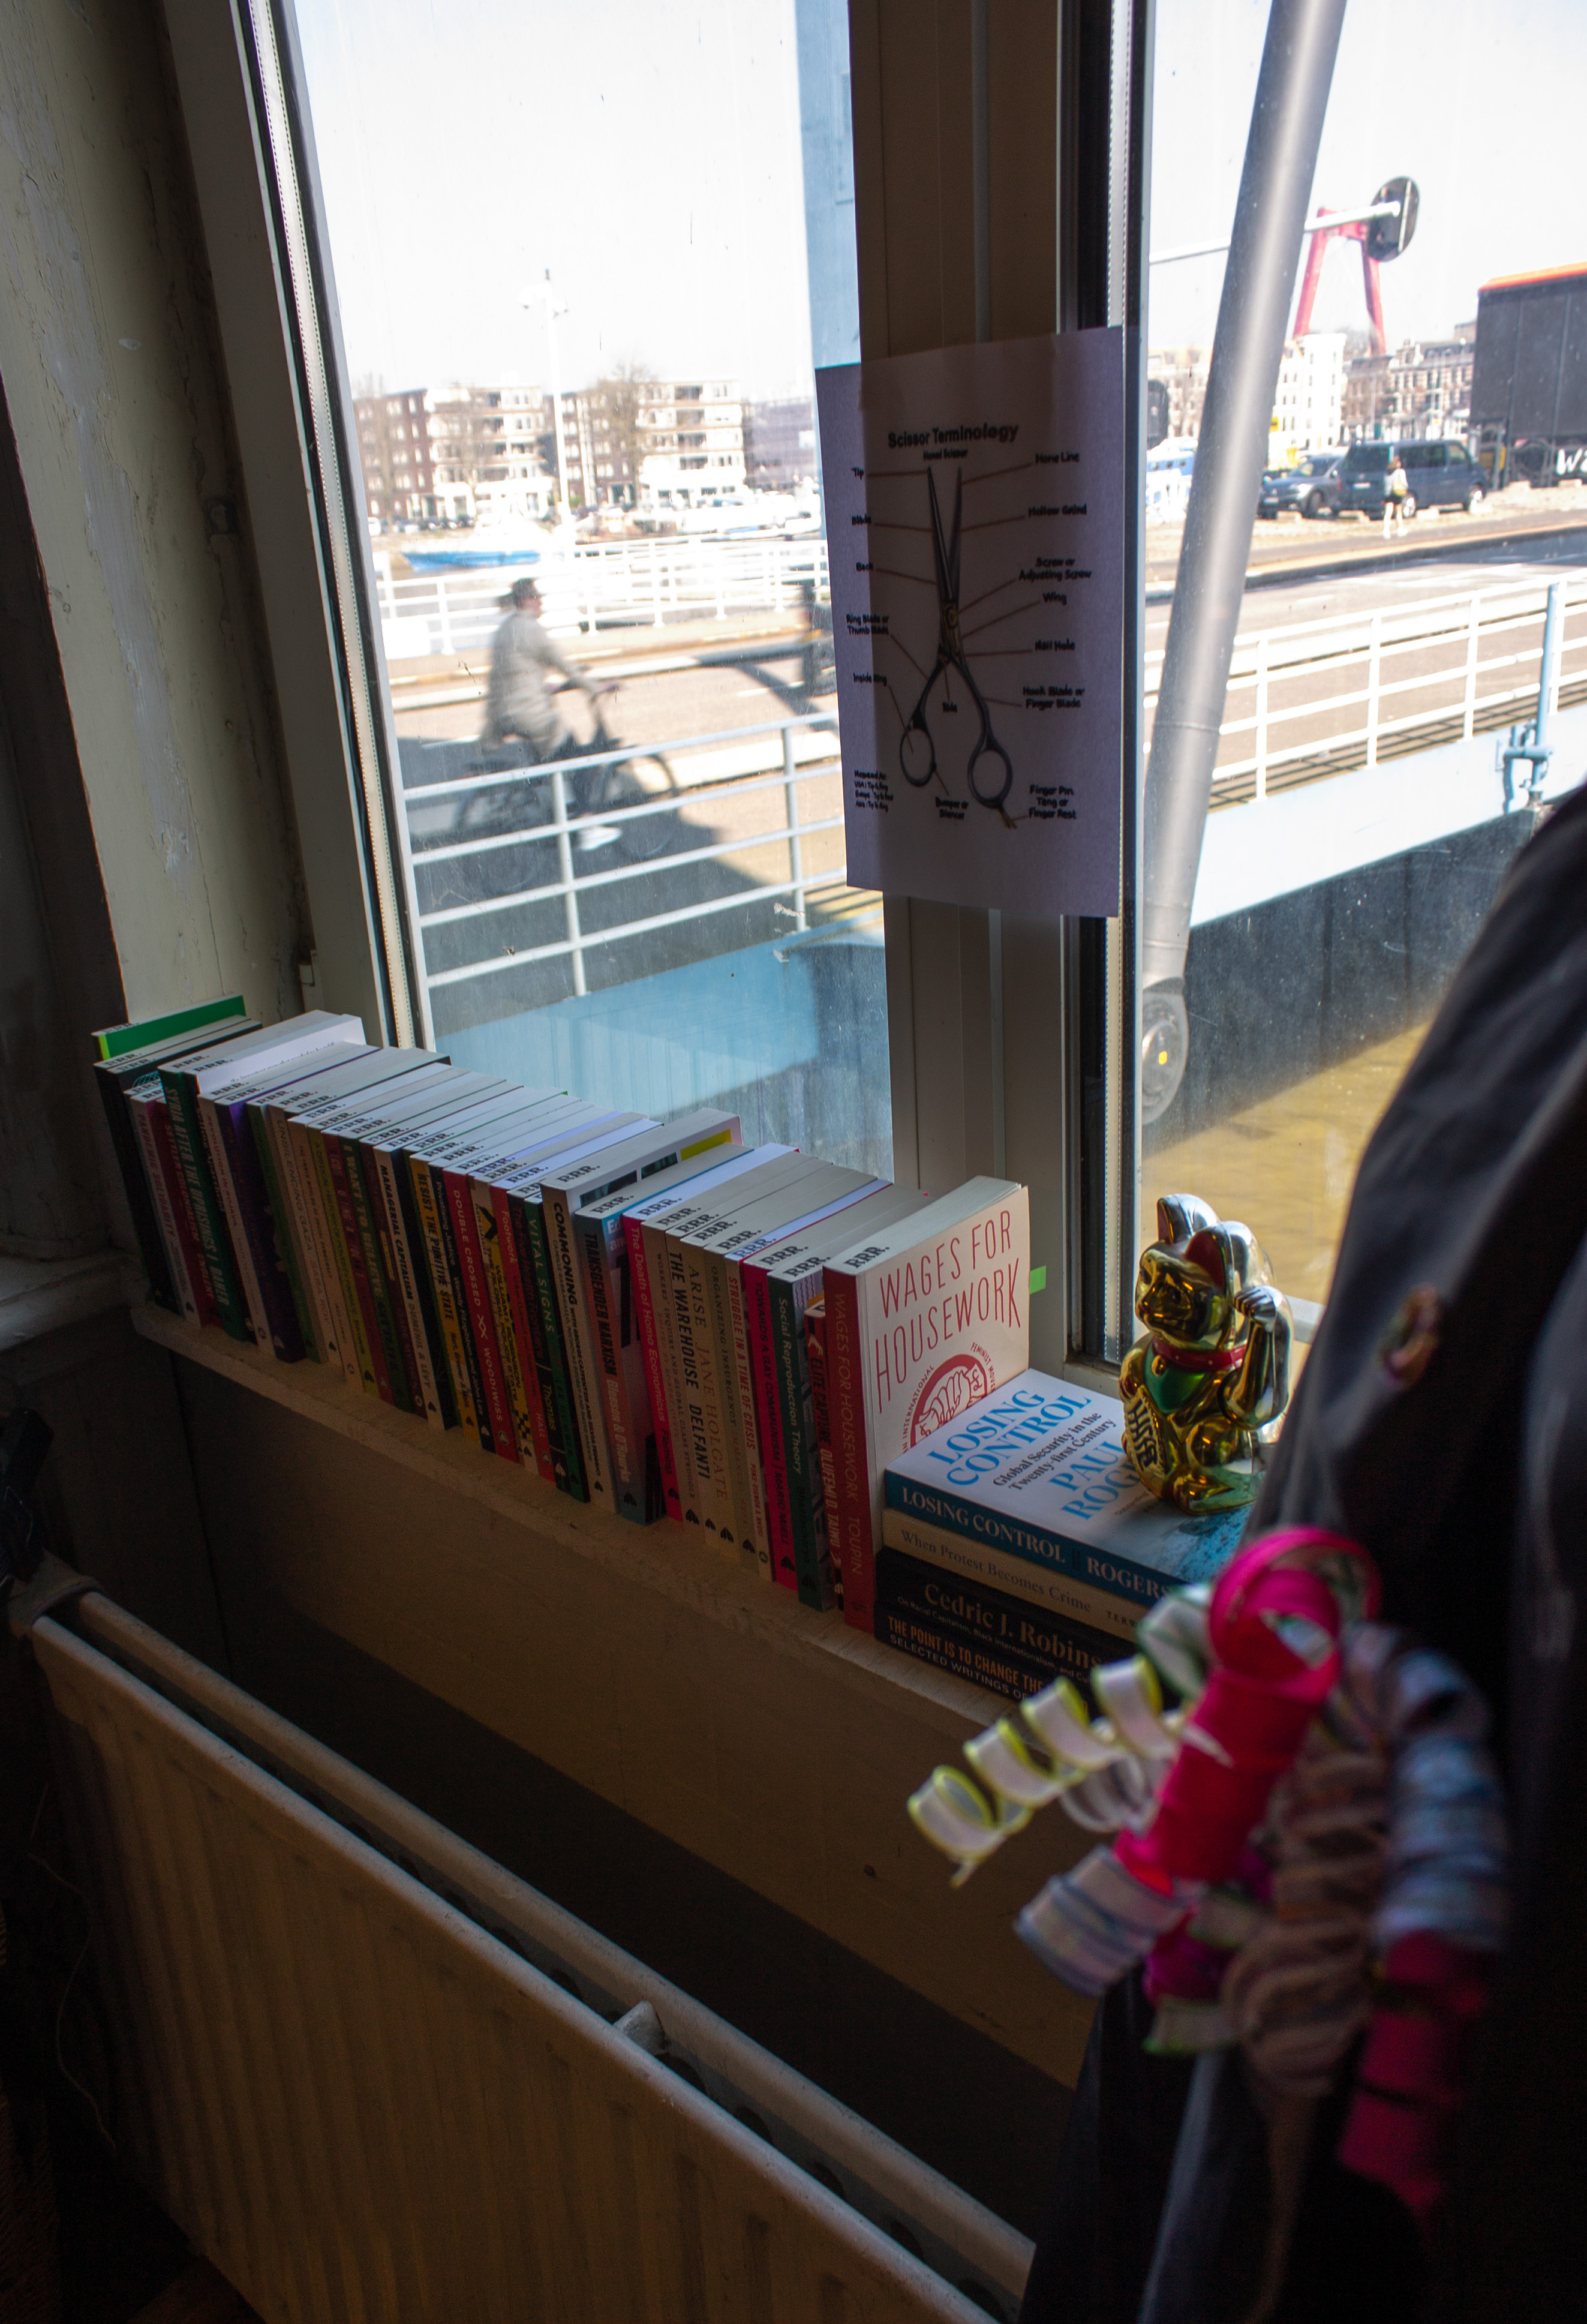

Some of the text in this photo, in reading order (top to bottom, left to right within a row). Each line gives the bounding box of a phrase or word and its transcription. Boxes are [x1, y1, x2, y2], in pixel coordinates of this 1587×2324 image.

[888, 423, 1018, 448] Scissor Terminology
[1061, 452, 1080, 463] Line
[1019, 569, 1092, 582] Adjusting Screw
[1042, 592, 1066, 605] Wing
[846, 614, 861, 626] Ring
[847, 625, 870, 635] Thumb
[1054, 638, 1075, 651] Hole
[853, 671, 871, 683] Inside
[1026, 698, 1054, 711] Finger
[1029, 807, 1077, 820] Finger Rest
[1030, 785, 1074, 796] Finger Pin
[1036, 797, 1057, 808] Tang
[138, 1114, 158, 1169] PANDEMIC
[152, 1173, 175, 1237] SOLIDARITY
[164, 1086, 217, 1253] SYRIA AFTER THE UPRISINGS
[164, 1124, 182, 1169] SETTLER
[176, 1172, 200, 1242] COLONIALISM
[346, 1156, 368, 1227] WANT TO
[484, 1163, 527, 1179] RRR.
[506, 1166, 549, 1183] RRR.
[557, 1166, 601, 1182] RRR.
[277, 1120, 323, 1294] UNSILENCING GAZA SARA
[590, 1195, 635, 1214] RRR.
[638, 1198, 683, 1215] RRR.
[656, 1208, 701, 1226] RRR.
[674, 1214, 720, 1233] RRR.
[380, 1165, 400, 1235] MANAGERIAL
[395, 1239, 413, 1300] CAPITALISM
[417, 1174, 454, 1321] RESIST THE PUNITIVE STATE
[693, 1220, 738, 1241] RRR.
[716, 1230, 762, 1250] RRR.
[732, 1237, 777, 1258] RRR.
[529, 1219, 554, 1334] VITAL SIGNS
[759, 1245, 808, 1265] RRR.
[783, 1256, 831, 1277] RRR.
[843, 1245, 890, 1269] RRR.
[880, 1211, 1011, 1318] WAGES FOR
[435, 1181, 450, 1230] Privatising
[445, 1232, 456, 1266] Justice
[453, 1277, 464, 1308] Wendy
[459, 1309, 473, 1356] Fitzgibbon
[472, 1376, 480, 1398] John
[453, 1190, 468, 1242] DOUBLE
[464, 1247, 481, 1307] CROSSED
[483, 1347, 503, 1422] WOODIWISS
[554, 1202, 589, 1403] COMMONING CAFFENTZIS
[728, 1277, 744, 1334] STRUGGLE
[755, 1281, 768, 1341] TOWARDS
[501, 1211, 545, 1437] Footwork HALL
[584, 1233, 624, 1433] TRANSGENDER MARXISM Gleeson &
[631, 1227, 665, 1422] The Death of Homo Economicus
[664, 1307, 675, 1350] INQUIRY
[711, 1266, 737, 1426] ORGANIZING INSURGENCY
[735, 1337, 745, 1349] IN
[876, 1258, 1021, 1413] HOUSEWORK
[669, 1252, 711, 1479] THE WAREHOUSE DELFANTI
[689, 1264, 728, 1501] ARISE JANE HOLGATE
[738, 1365, 749, 1392] TIME
[762, 1356, 772, 1378] GAY
[778, 1298, 802, 1475] Social Reproduction Theory
[810, 1358, 826, 1389] ELITE
[542, 1385, 556, 1431] Thomas
[674, 1378, 683, 1415] GLOBAL
[741, 1395, 751, 1409] OF
[903, 1342, 991, 1439] INTERNATIONAL FEMINIST
[680, 1420, 689, 1448] CLASS
[743, 1412, 755, 1449] CRISIS
[765, 1382, 780, 1461] COMMUNISM
[814, 1392, 831, 1445] CAPTURE
[835, 1293, 862, 1575] WAGES FOR HOUSEWORK TOUPIN
[927, 1390, 1046, 1466] LOSING
[946, 1395, 1092, 1486] CONTROL
[993, 1412, 1102, 1486] Global Security in the
[1008, 1445, 1077, 1491] Twenty-first
[1072, 1419, 1116, 1448] Century
[684, 1452, 695, 1499] STRUGGLE
[775, 1473, 786, 1510] MARIO
[779, 1512, 789, 1545] MIELI
[902, 1486, 969, 1526] LOSING
[973, 1514, 1066, 1564] CONTROL
[901, 1529, 1092, 1613] When Protest Becomes Crime
[924, 1583, 994, 1629] Cedric
[1000, 1613, 1015, 1637] J.
[888, 1615, 907, 1638] THE
[910, 1625, 942, 1652] POINT
[944, 1640, 955, 1659] IS
[958, 1646, 972, 1665] TO
[975, 1654, 1019, 1686] CHANGE
[910, 1602, 930, 1616] Racial
[973, 1628, 993, 1642] Black
[1059, 1668, 1074, 1678] and
[890, 1634, 1009, 1695] SELECTED WRITINGS
